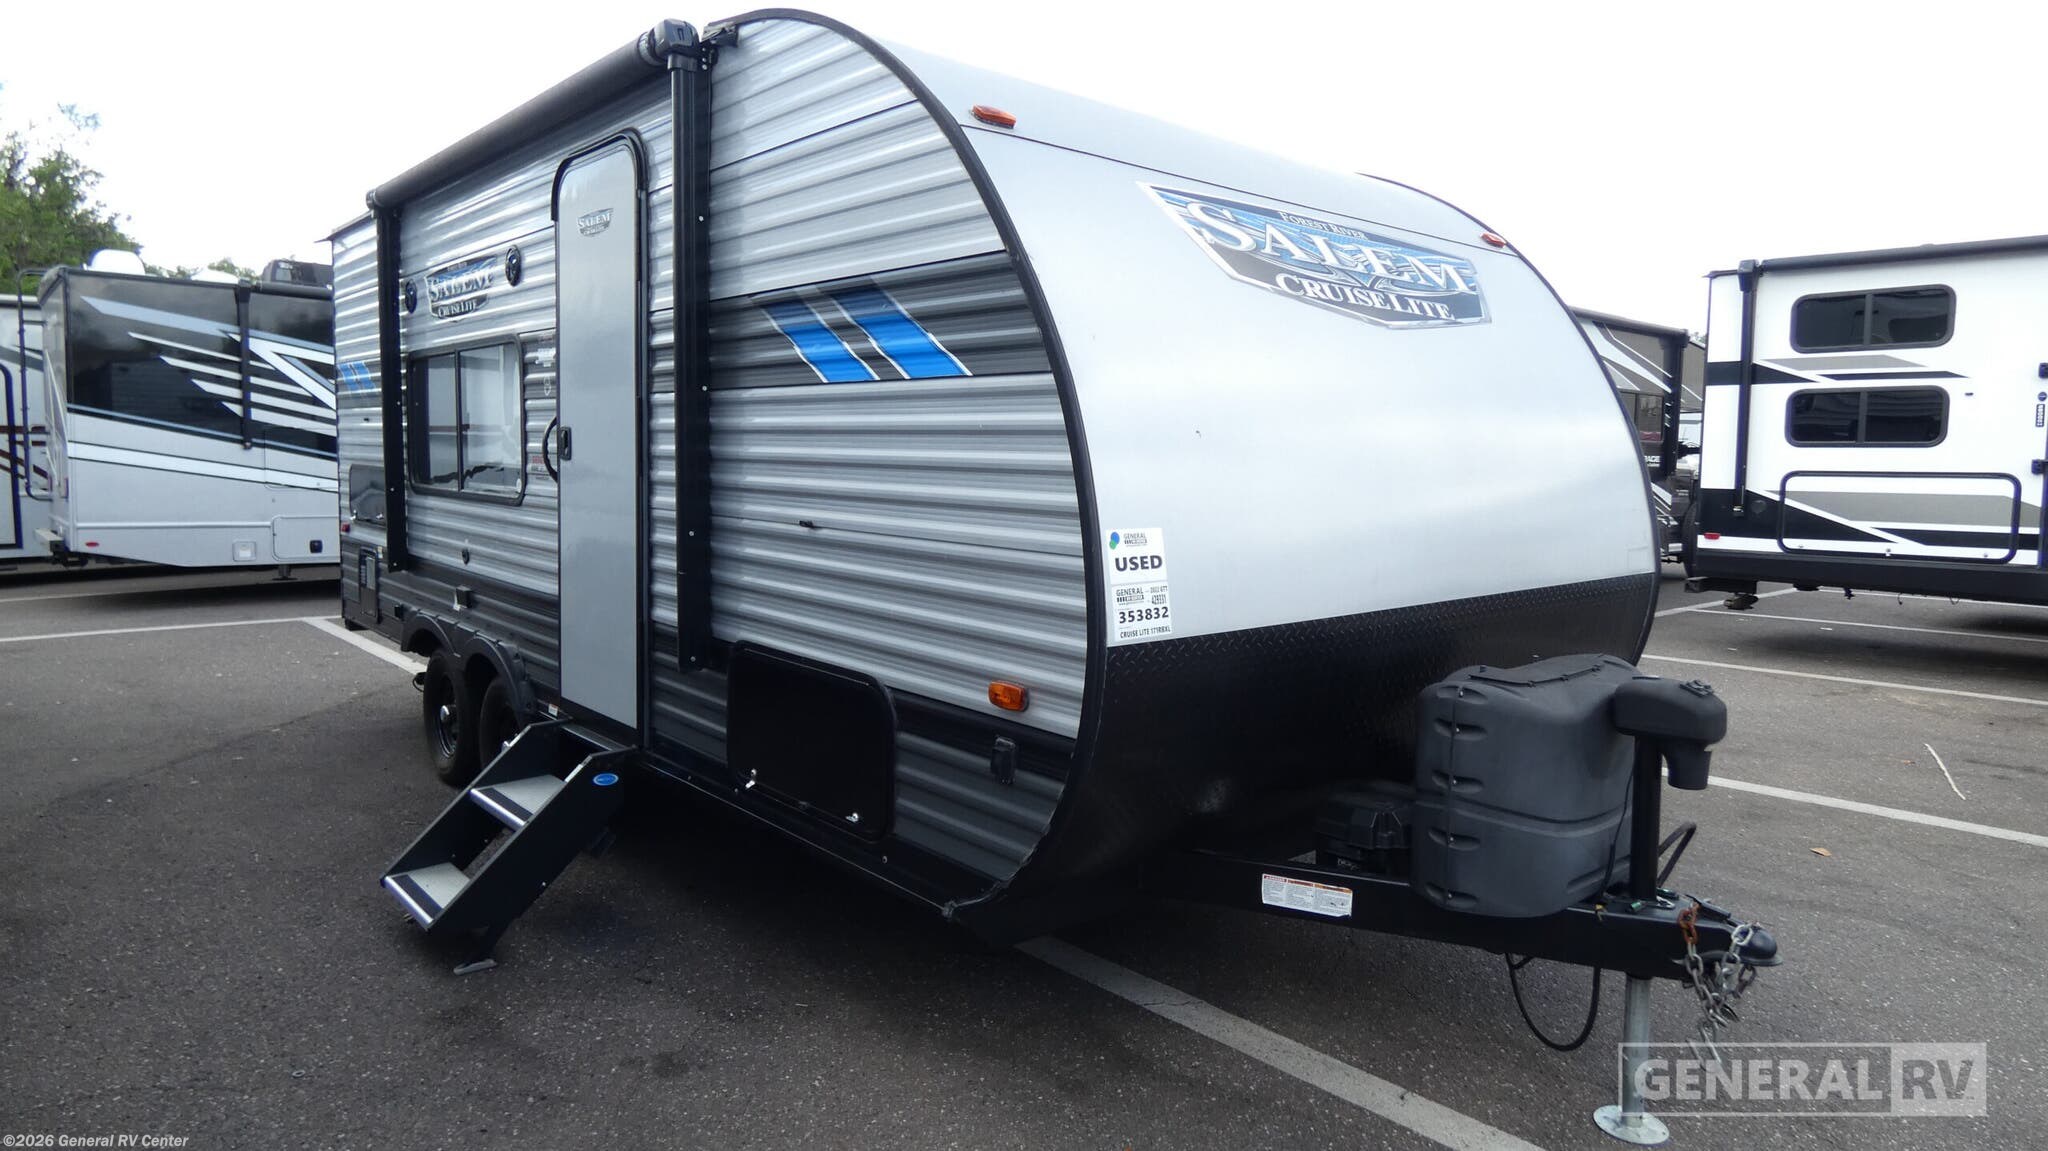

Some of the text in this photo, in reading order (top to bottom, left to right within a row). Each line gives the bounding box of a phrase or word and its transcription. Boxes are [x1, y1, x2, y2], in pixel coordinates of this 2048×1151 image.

[1186, 201, 1477, 294] SALEM
[1115, 554, 1163, 572] USED
[1116, 587, 1144, 597] GENERAL
[1119, 606, 1169, 624] 353832
[1120, 630, 1139, 639] CRUISE
[1139, 628, 1150, 636] LITE
